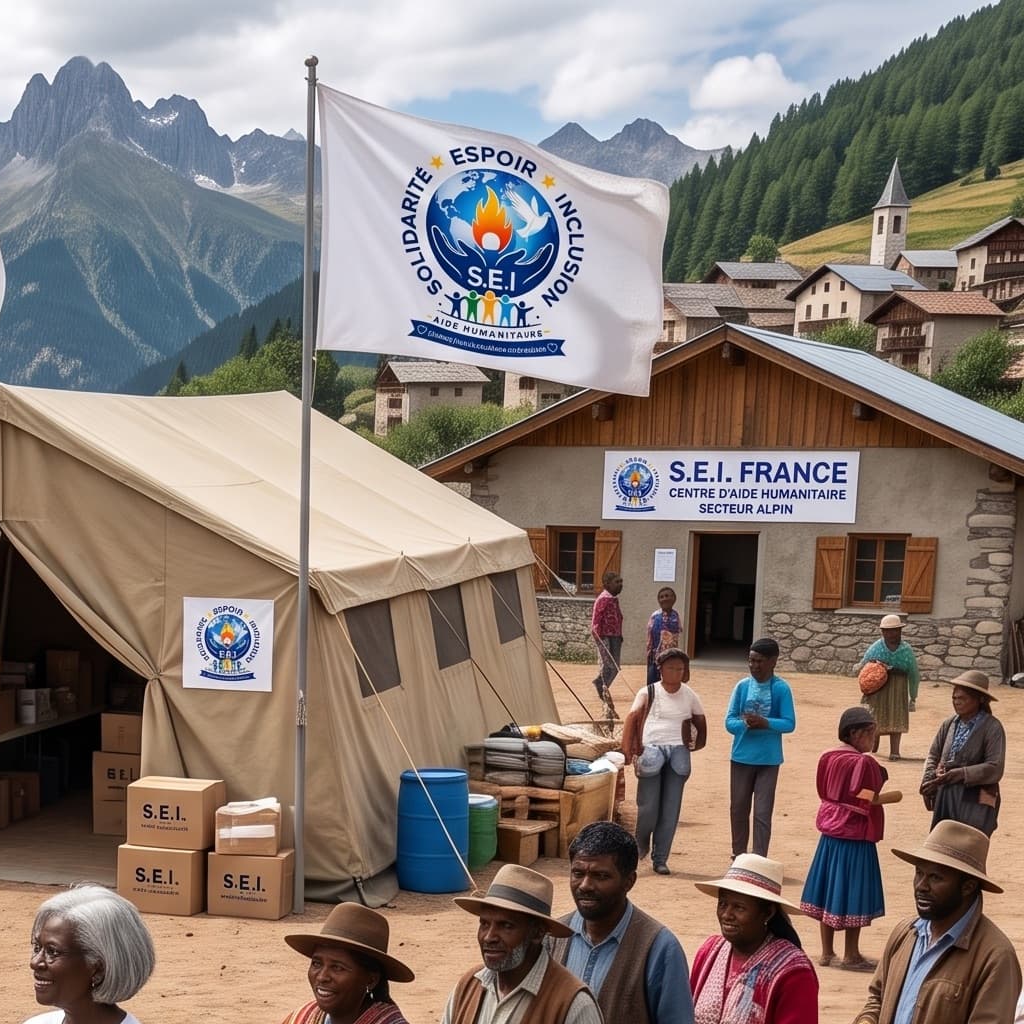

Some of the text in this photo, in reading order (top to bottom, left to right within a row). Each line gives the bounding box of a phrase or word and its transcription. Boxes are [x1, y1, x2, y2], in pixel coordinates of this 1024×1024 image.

[449, 146, 537, 179] ESPOIR
[401, 166, 442, 296] SOLIDARITÉ
[541, 193, 585, 307] INCLUSION
[467, 266, 516, 291] S.E.I
[432, 316, 459, 330] AIDE
[669, 461, 732, 483] S.E.I.
[740, 461, 848, 484] FRANCE
[669, 488, 847, 501] CENTRE D'AIDE HUMANITAIRE
[698, 503, 794, 515] SECTEUR ALPIN
[143, 804, 186, 821] S.E.I.
[135, 867, 179, 885] S.E.I.
[223, 873, 266, 892] S.E.I.
